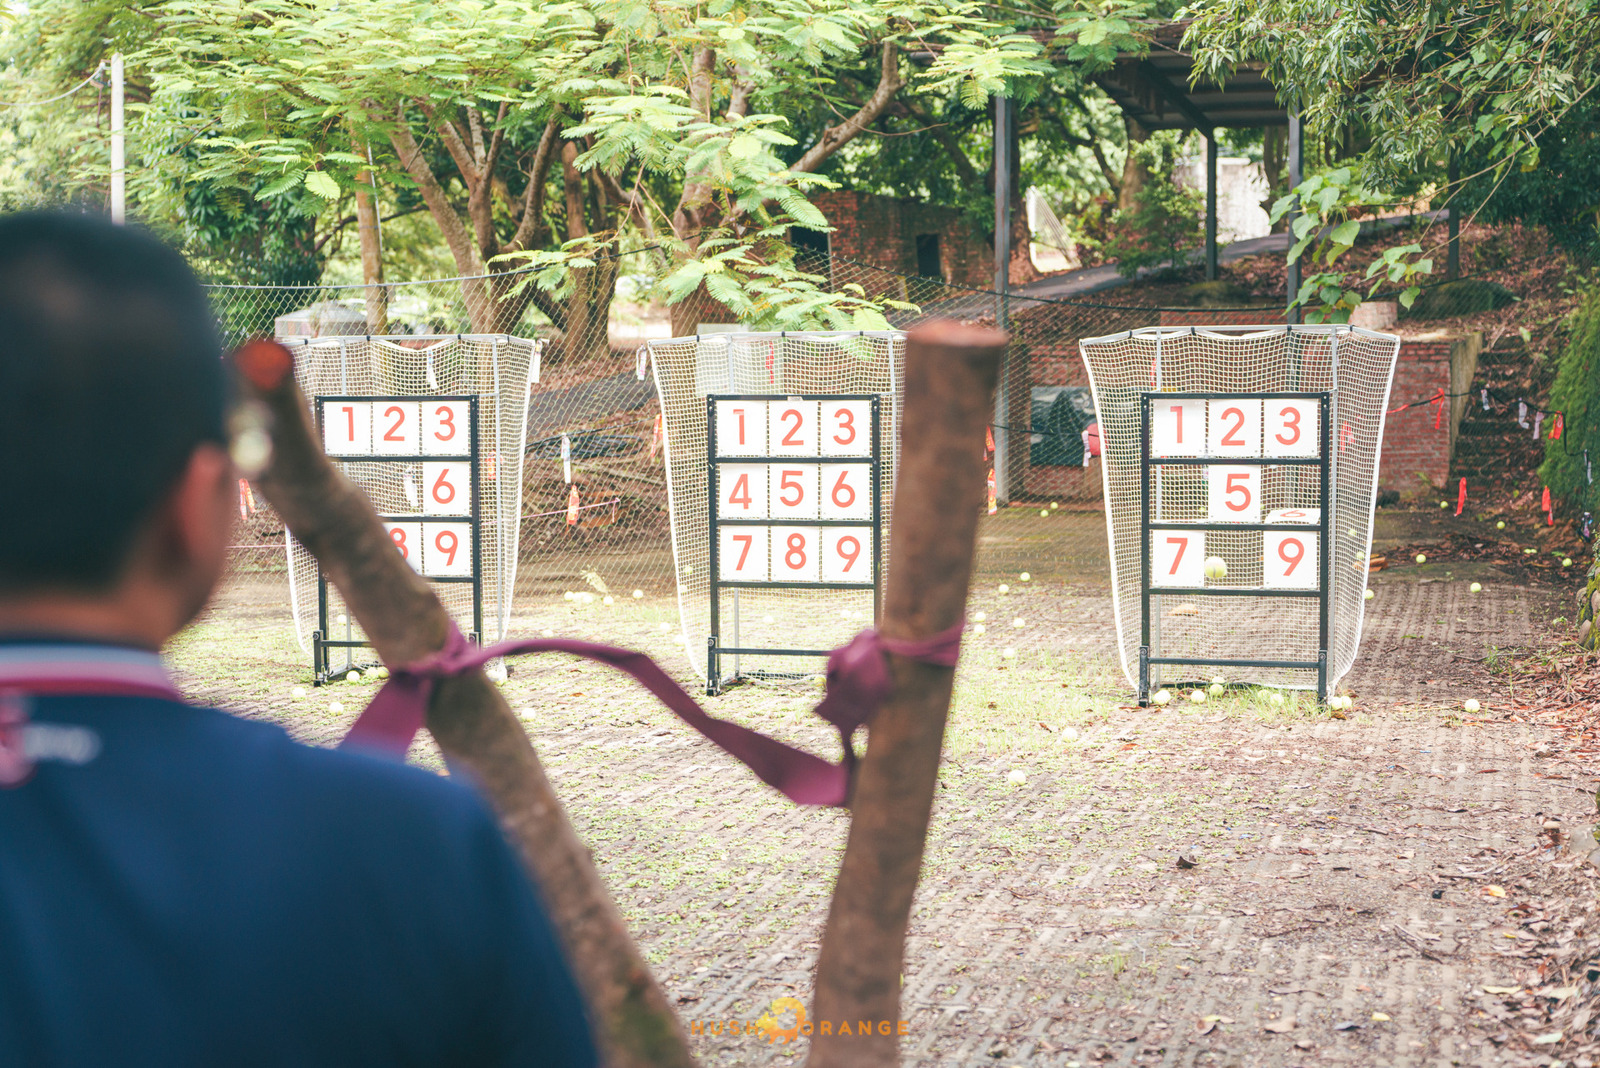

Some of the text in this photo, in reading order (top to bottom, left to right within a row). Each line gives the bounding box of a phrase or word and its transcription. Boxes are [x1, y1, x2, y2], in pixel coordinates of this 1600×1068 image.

[342, 405, 456, 442] 1 2 3
[732, 408, 856, 446] 1 2 3
[1169, 405, 1301, 446] 1 2 3
[432, 468, 456, 504] 6
[728, 470, 856, 510] 4 5 6
[1225, 473, 1252, 512] 5
[435, 530, 458, 567] 9
[732, 533, 861, 573] 7 8 9
[1166, 537, 1188, 576] 7
[1277, 537, 1305, 577] 9
